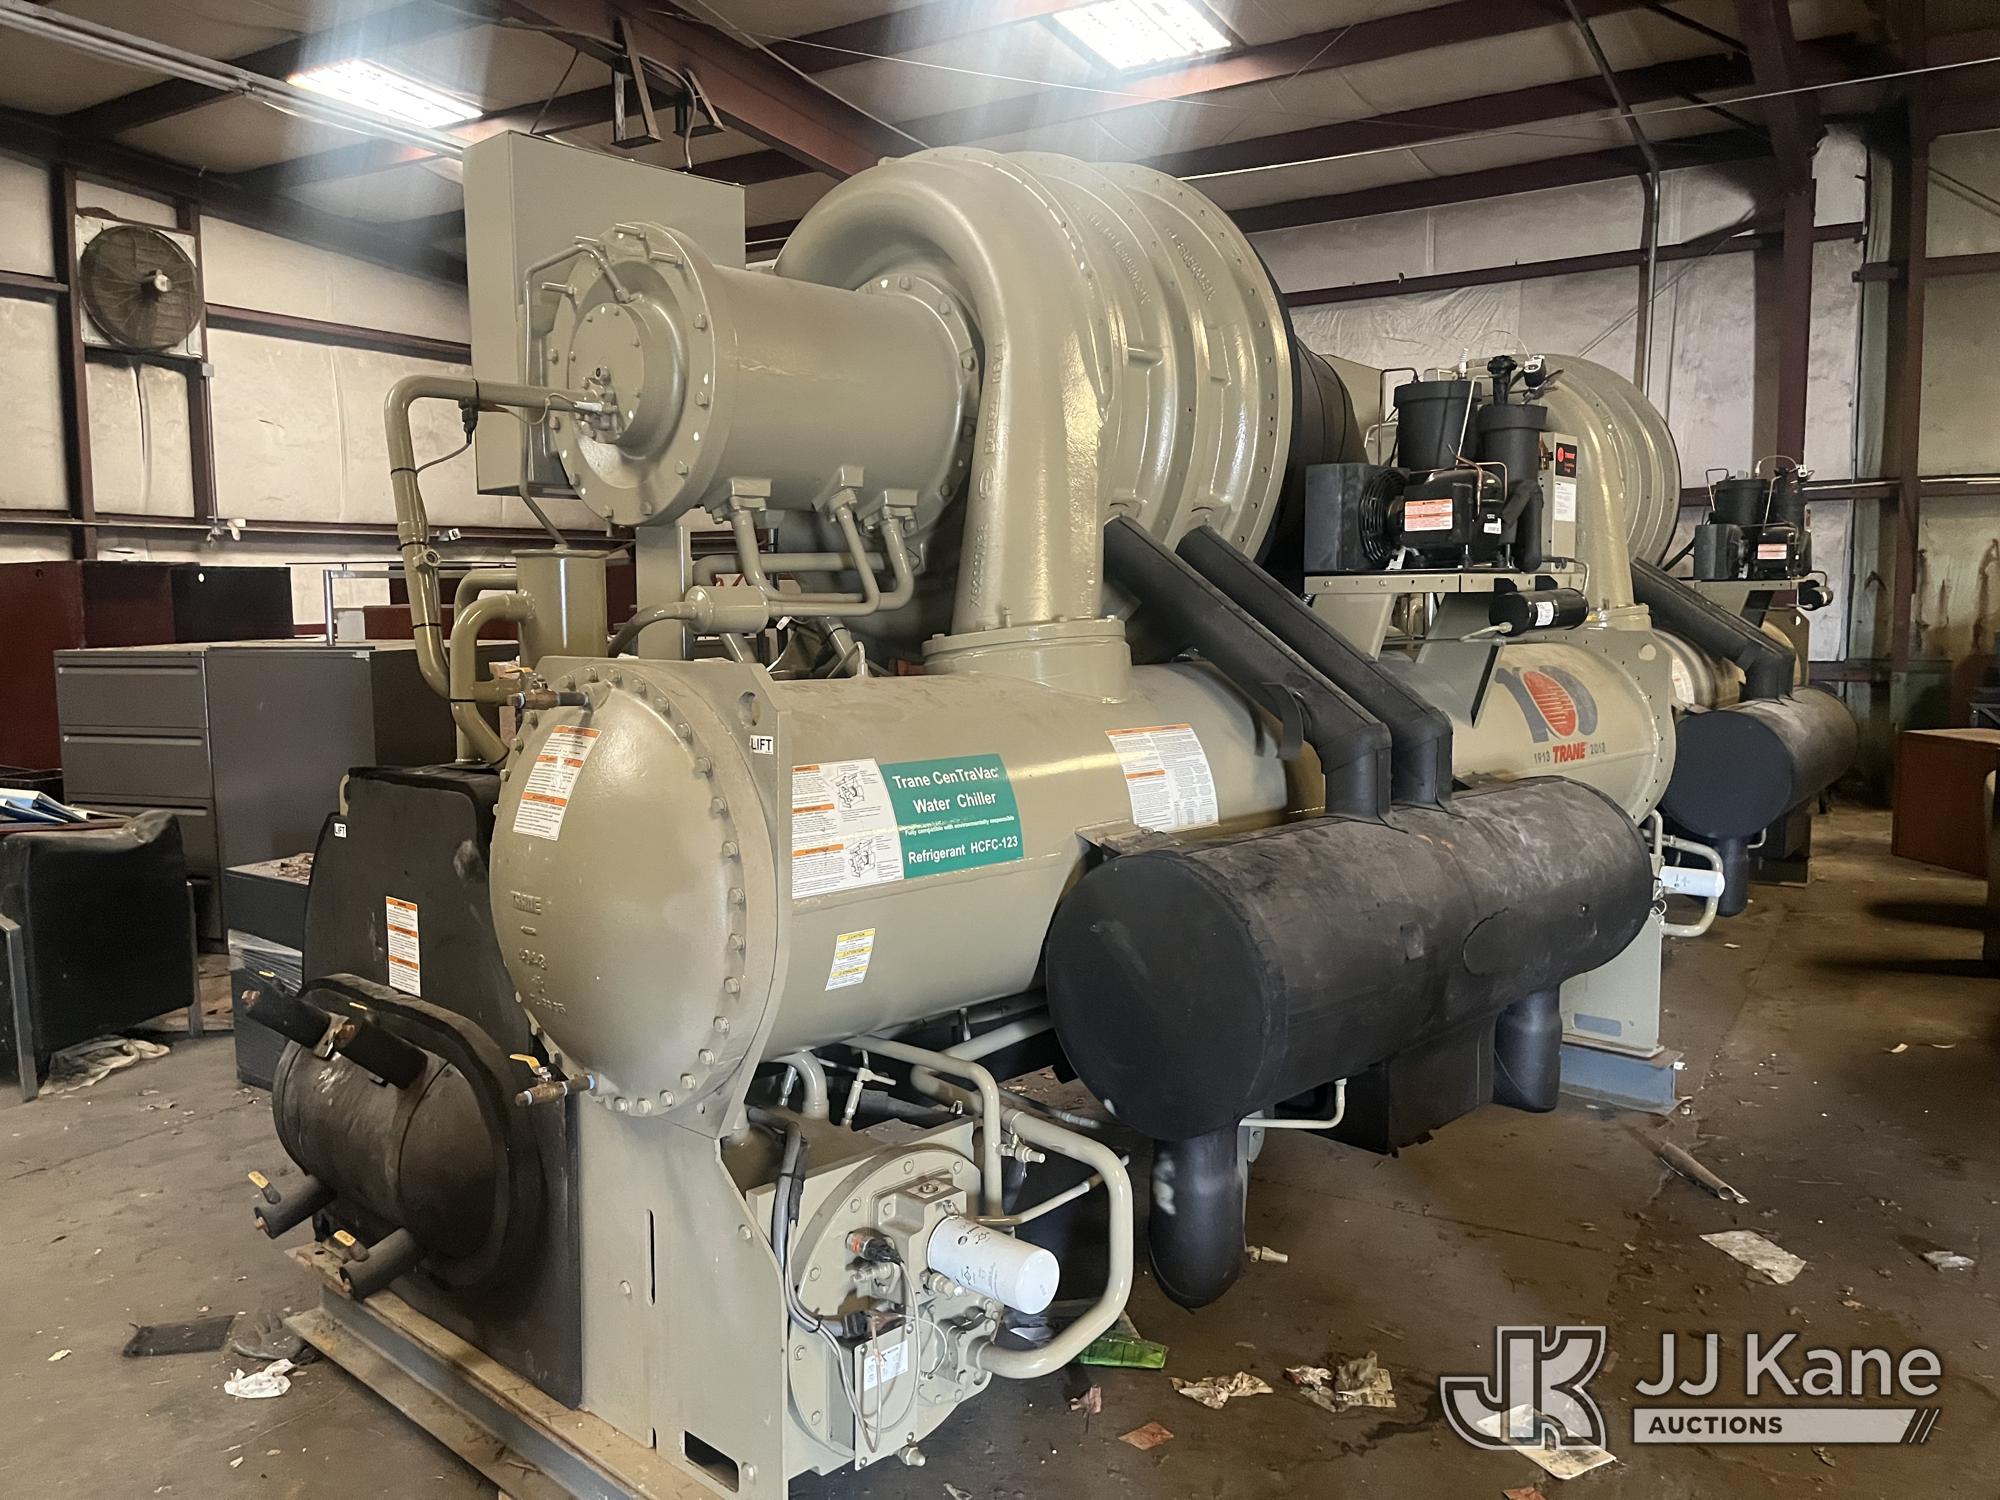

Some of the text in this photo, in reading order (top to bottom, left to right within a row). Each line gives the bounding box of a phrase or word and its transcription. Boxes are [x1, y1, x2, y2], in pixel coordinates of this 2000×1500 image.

[751, 738, 772, 751] LIFT
[1534, 751, 1550, 763] 1913
[1553, 742, 1587, 763] TRANE
[892, 775, 931, 789] Trane
[913, 792, 996, 814] Water Chiller
[908, 836, 1018, 864] Refrigerant HCFC-123
